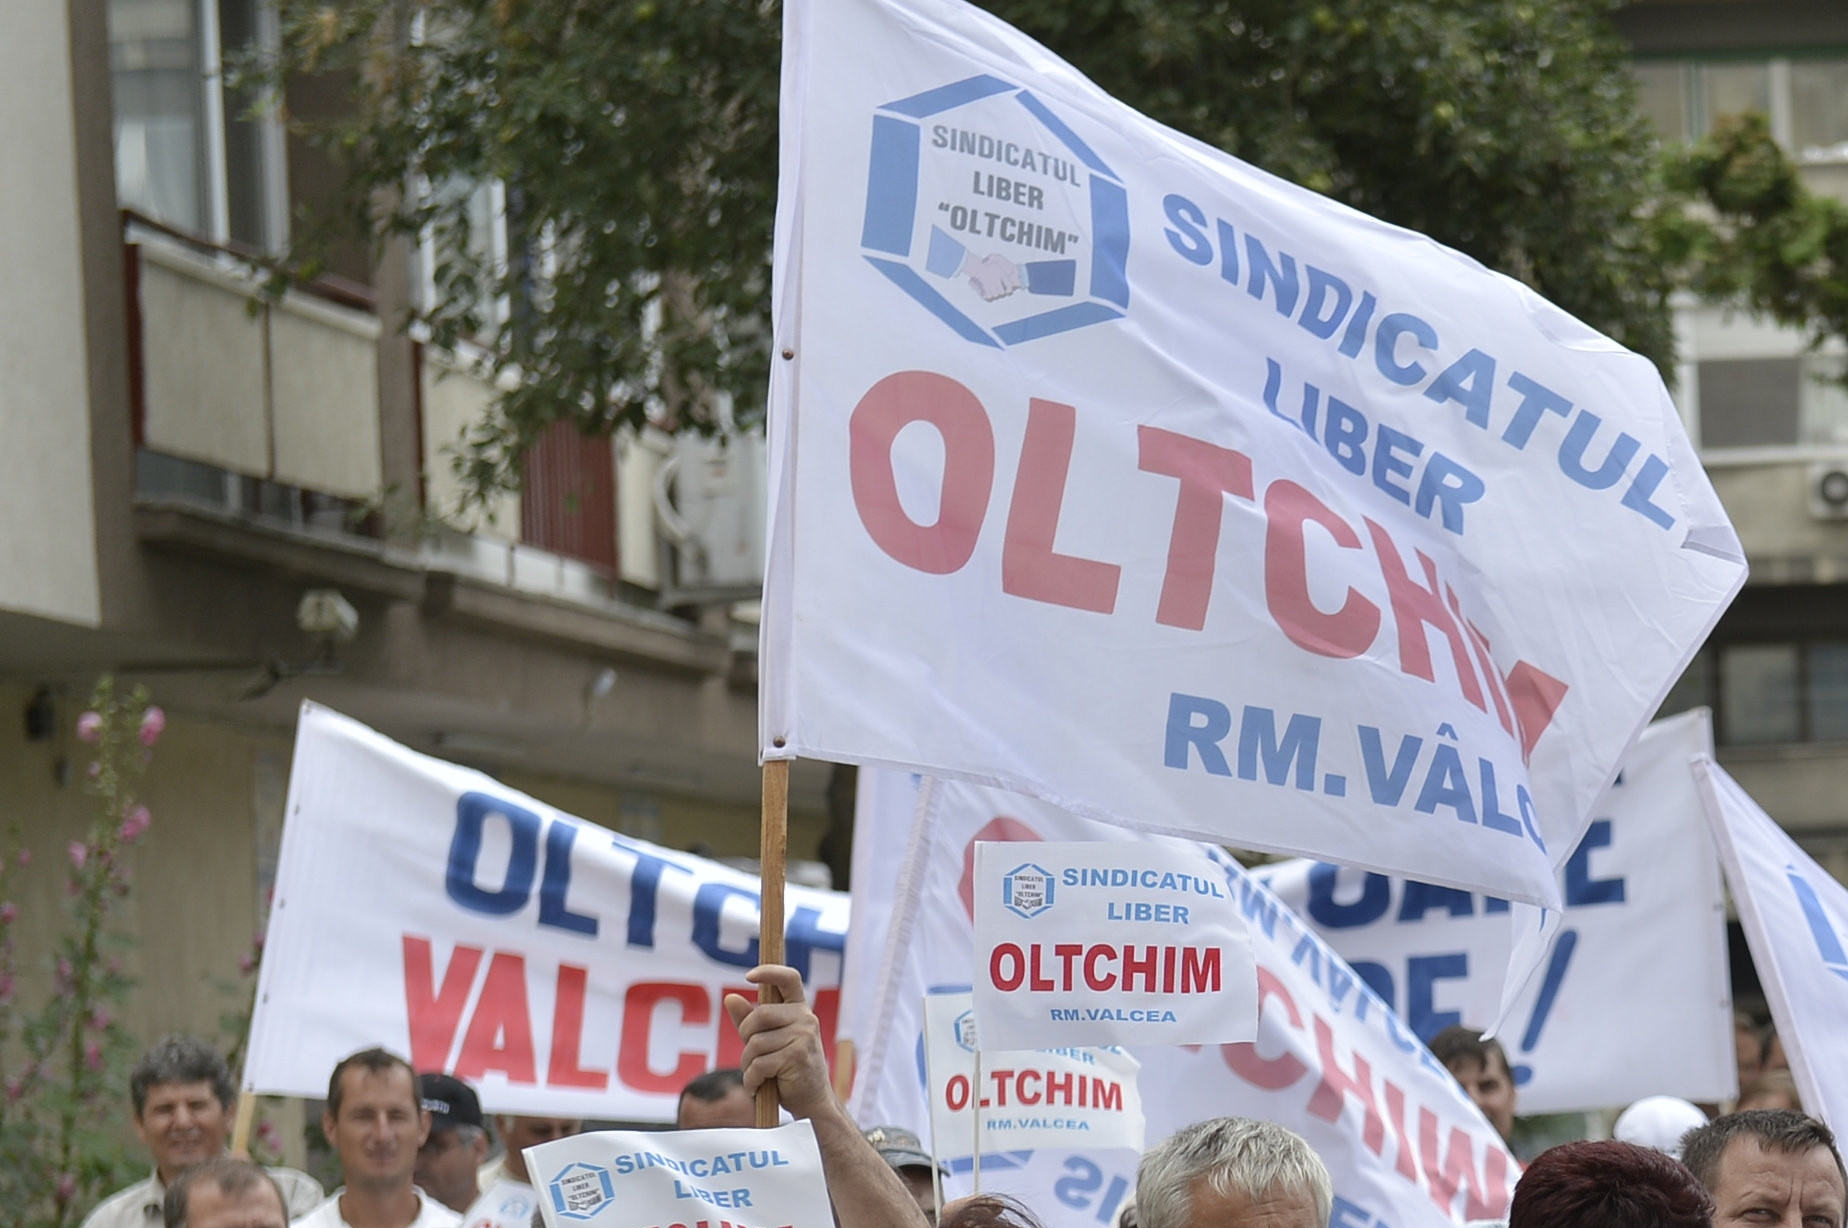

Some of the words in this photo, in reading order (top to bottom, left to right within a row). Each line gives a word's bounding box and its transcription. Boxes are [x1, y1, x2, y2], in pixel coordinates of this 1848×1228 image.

[931, 124, 1082, 189] SINDICATUL
[972, 170, 1045, 211] LIBER
[1162, 193, 1676, 532] SINDICATUL
[1264, 357, 1485, 535] LIBER
[1163, 692, 1548, 856] RM.VÂLC
[1062, 868, 1224, 899] SINDICATUL
[1107, 902, 1190, 925] LIBER
[989, 942, 1222, 994] OLTCHIM
[402, 932, 857, 1098] VALC
[1050, 1008, 1177, 1023] RM.VALCEA
[987, 1118, 1090, 1132] RM.VALCEA
[614, 1149, 789, 1178] SINDICATUL
[674, 1180, 752, 1209] LIBER
